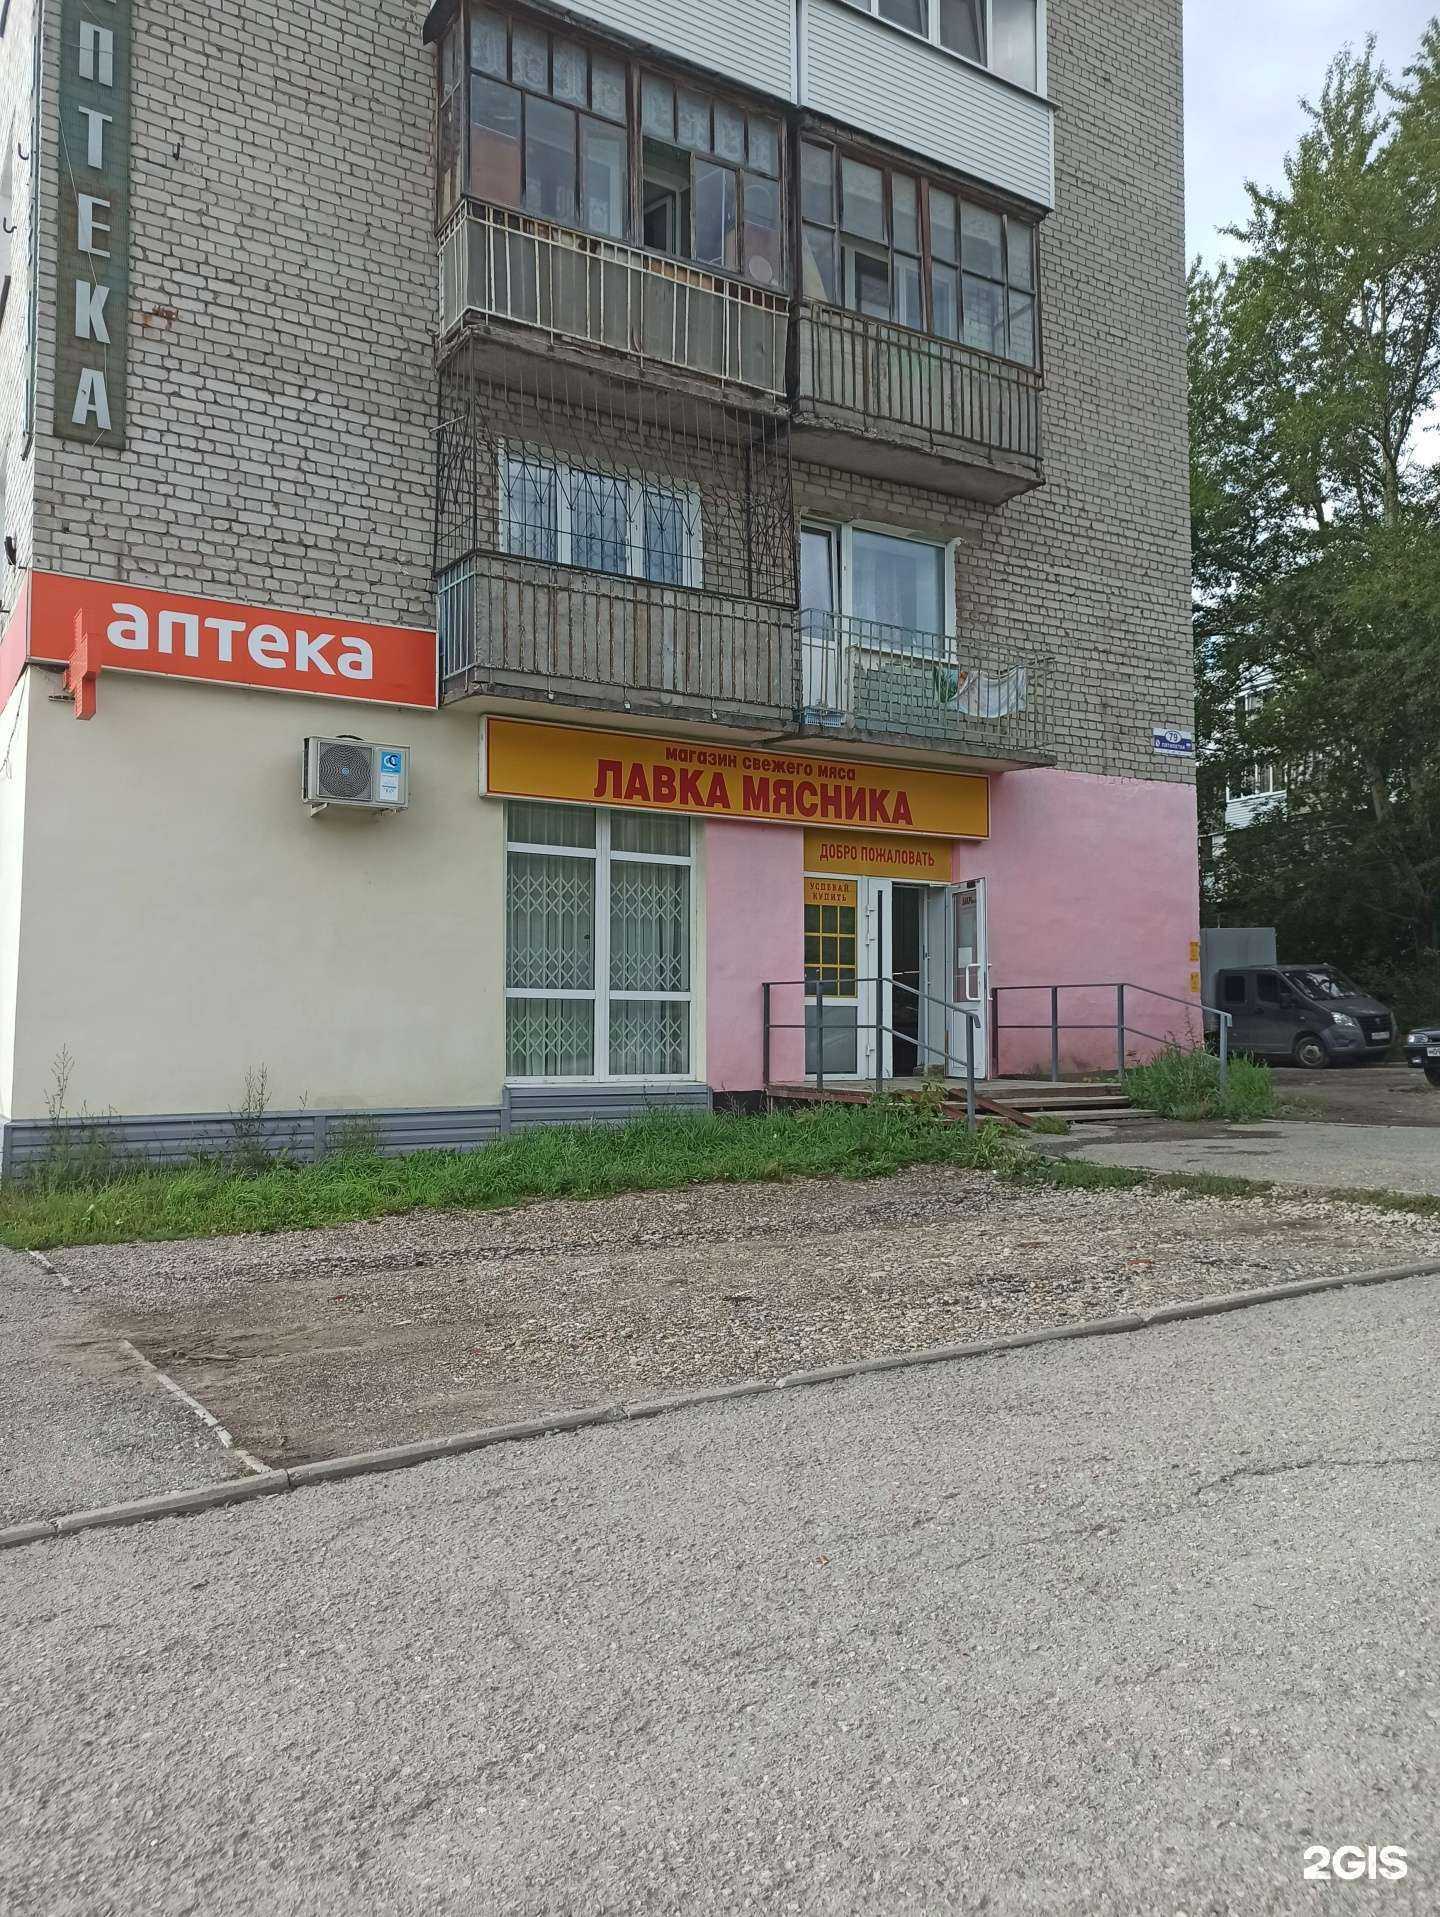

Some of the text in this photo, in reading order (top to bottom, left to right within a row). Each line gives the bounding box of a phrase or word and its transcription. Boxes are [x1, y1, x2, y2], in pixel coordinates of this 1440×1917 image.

[72, 0, 116, 432] ПТЕКА
[107, 602, 374, 681] аптека
[1169, 732, 1178, 742] 79
[665, 746, 856, 781] магазин свежего мяса
[593, 758, 914, 826] ЛАВКА МЯСНИКА
[819, 843, 935, 867] ДОБРО ПОЖАЛОВАТЬ
[812, 892, 847, 902] КУПИТЬ
